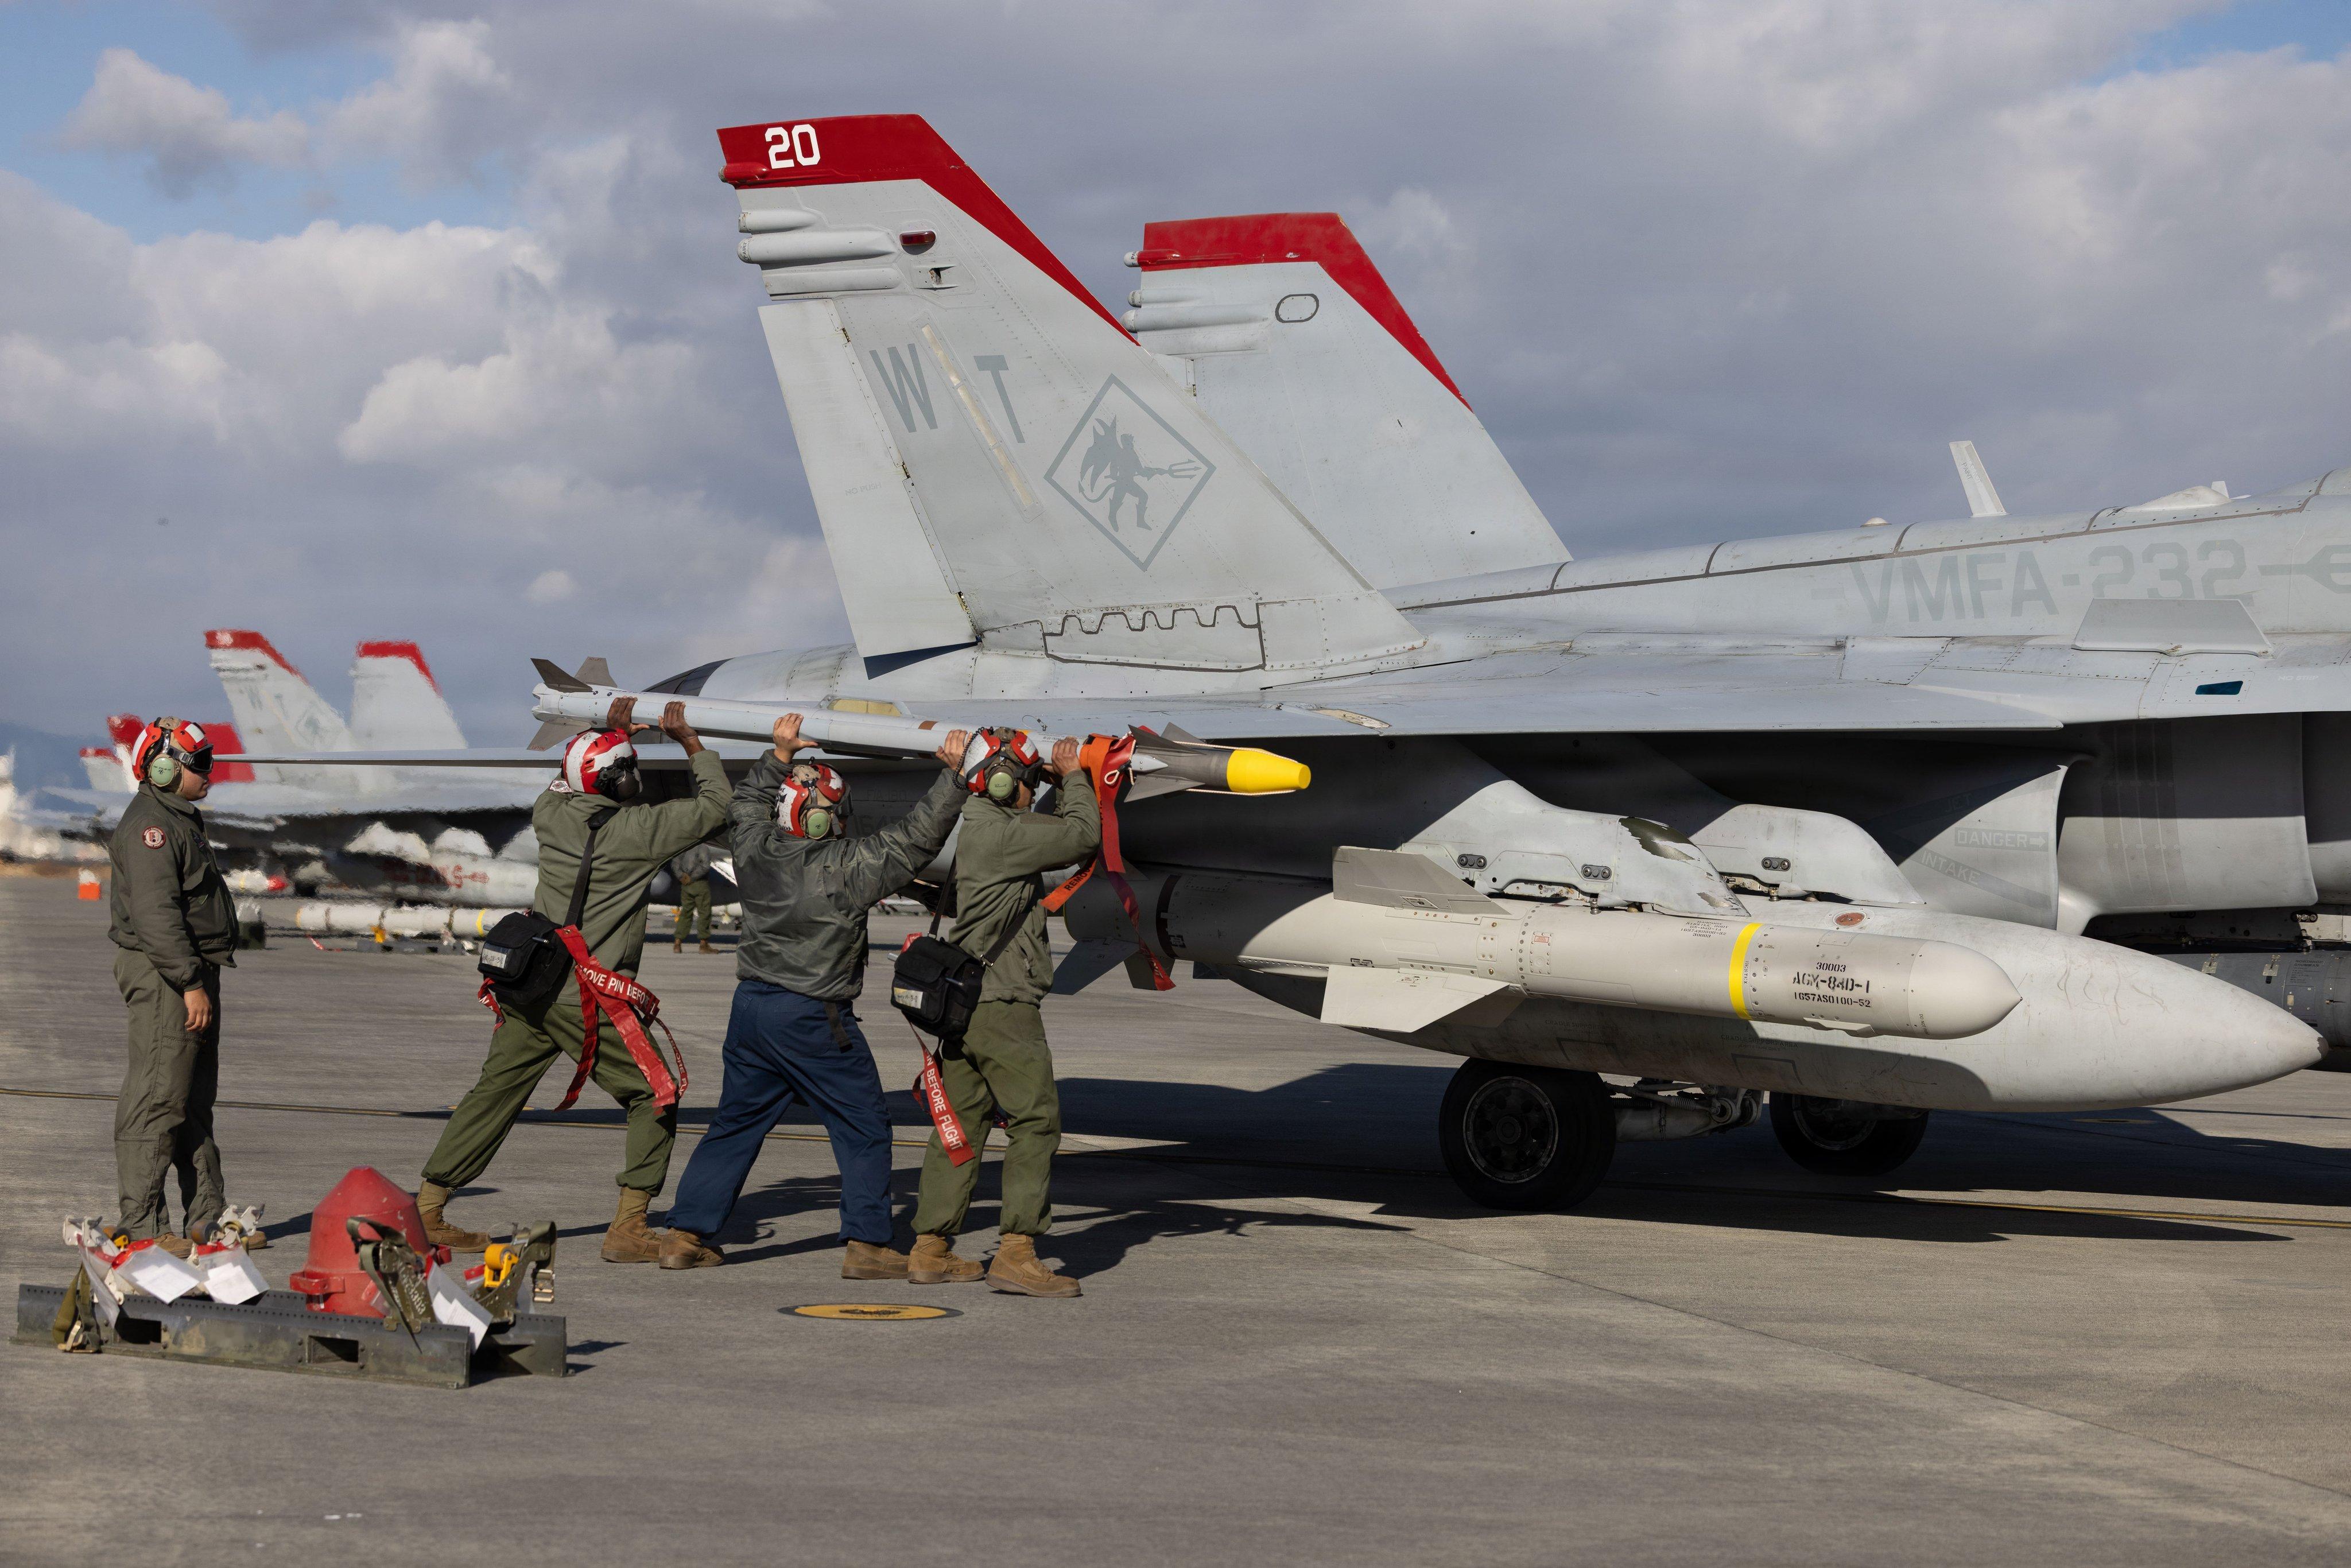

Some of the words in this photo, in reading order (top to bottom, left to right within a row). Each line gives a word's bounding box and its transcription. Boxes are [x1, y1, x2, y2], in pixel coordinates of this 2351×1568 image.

[765, 124, 820, 169] 20
[868, 344, 938, 433] W
[974, 355, 1025, 444] T
[1961, 462, 1973, 480] PAINT
[845, 487, 859, 496] NO
[860, 482, 882, 492] PUSH
[1850, 539, 2253, 624] VMFA-232
[1945, 793, 1972, 812] JET
[1957, 830, 2027, 848] DANGER
[1922, 851, 1980, 884] INTAKE
[1816, 962, 1846, 972] 30003
[607, 977, 625, 993] PIN
[1793, 972, 1870, 993] AGM-84D-1
[1794, 992, 1871, 1008] 1657AS0100-52
[1721, 1034, 1748, 1043] CRADLE
[1748, 1037, 1779, 1046] SUPPORT
[1780, 1041, 1800, 1049] AREA
[927, 1068, 947, 1113] BEFORE
[938, 1114, 964, 1150] FLIGHT
